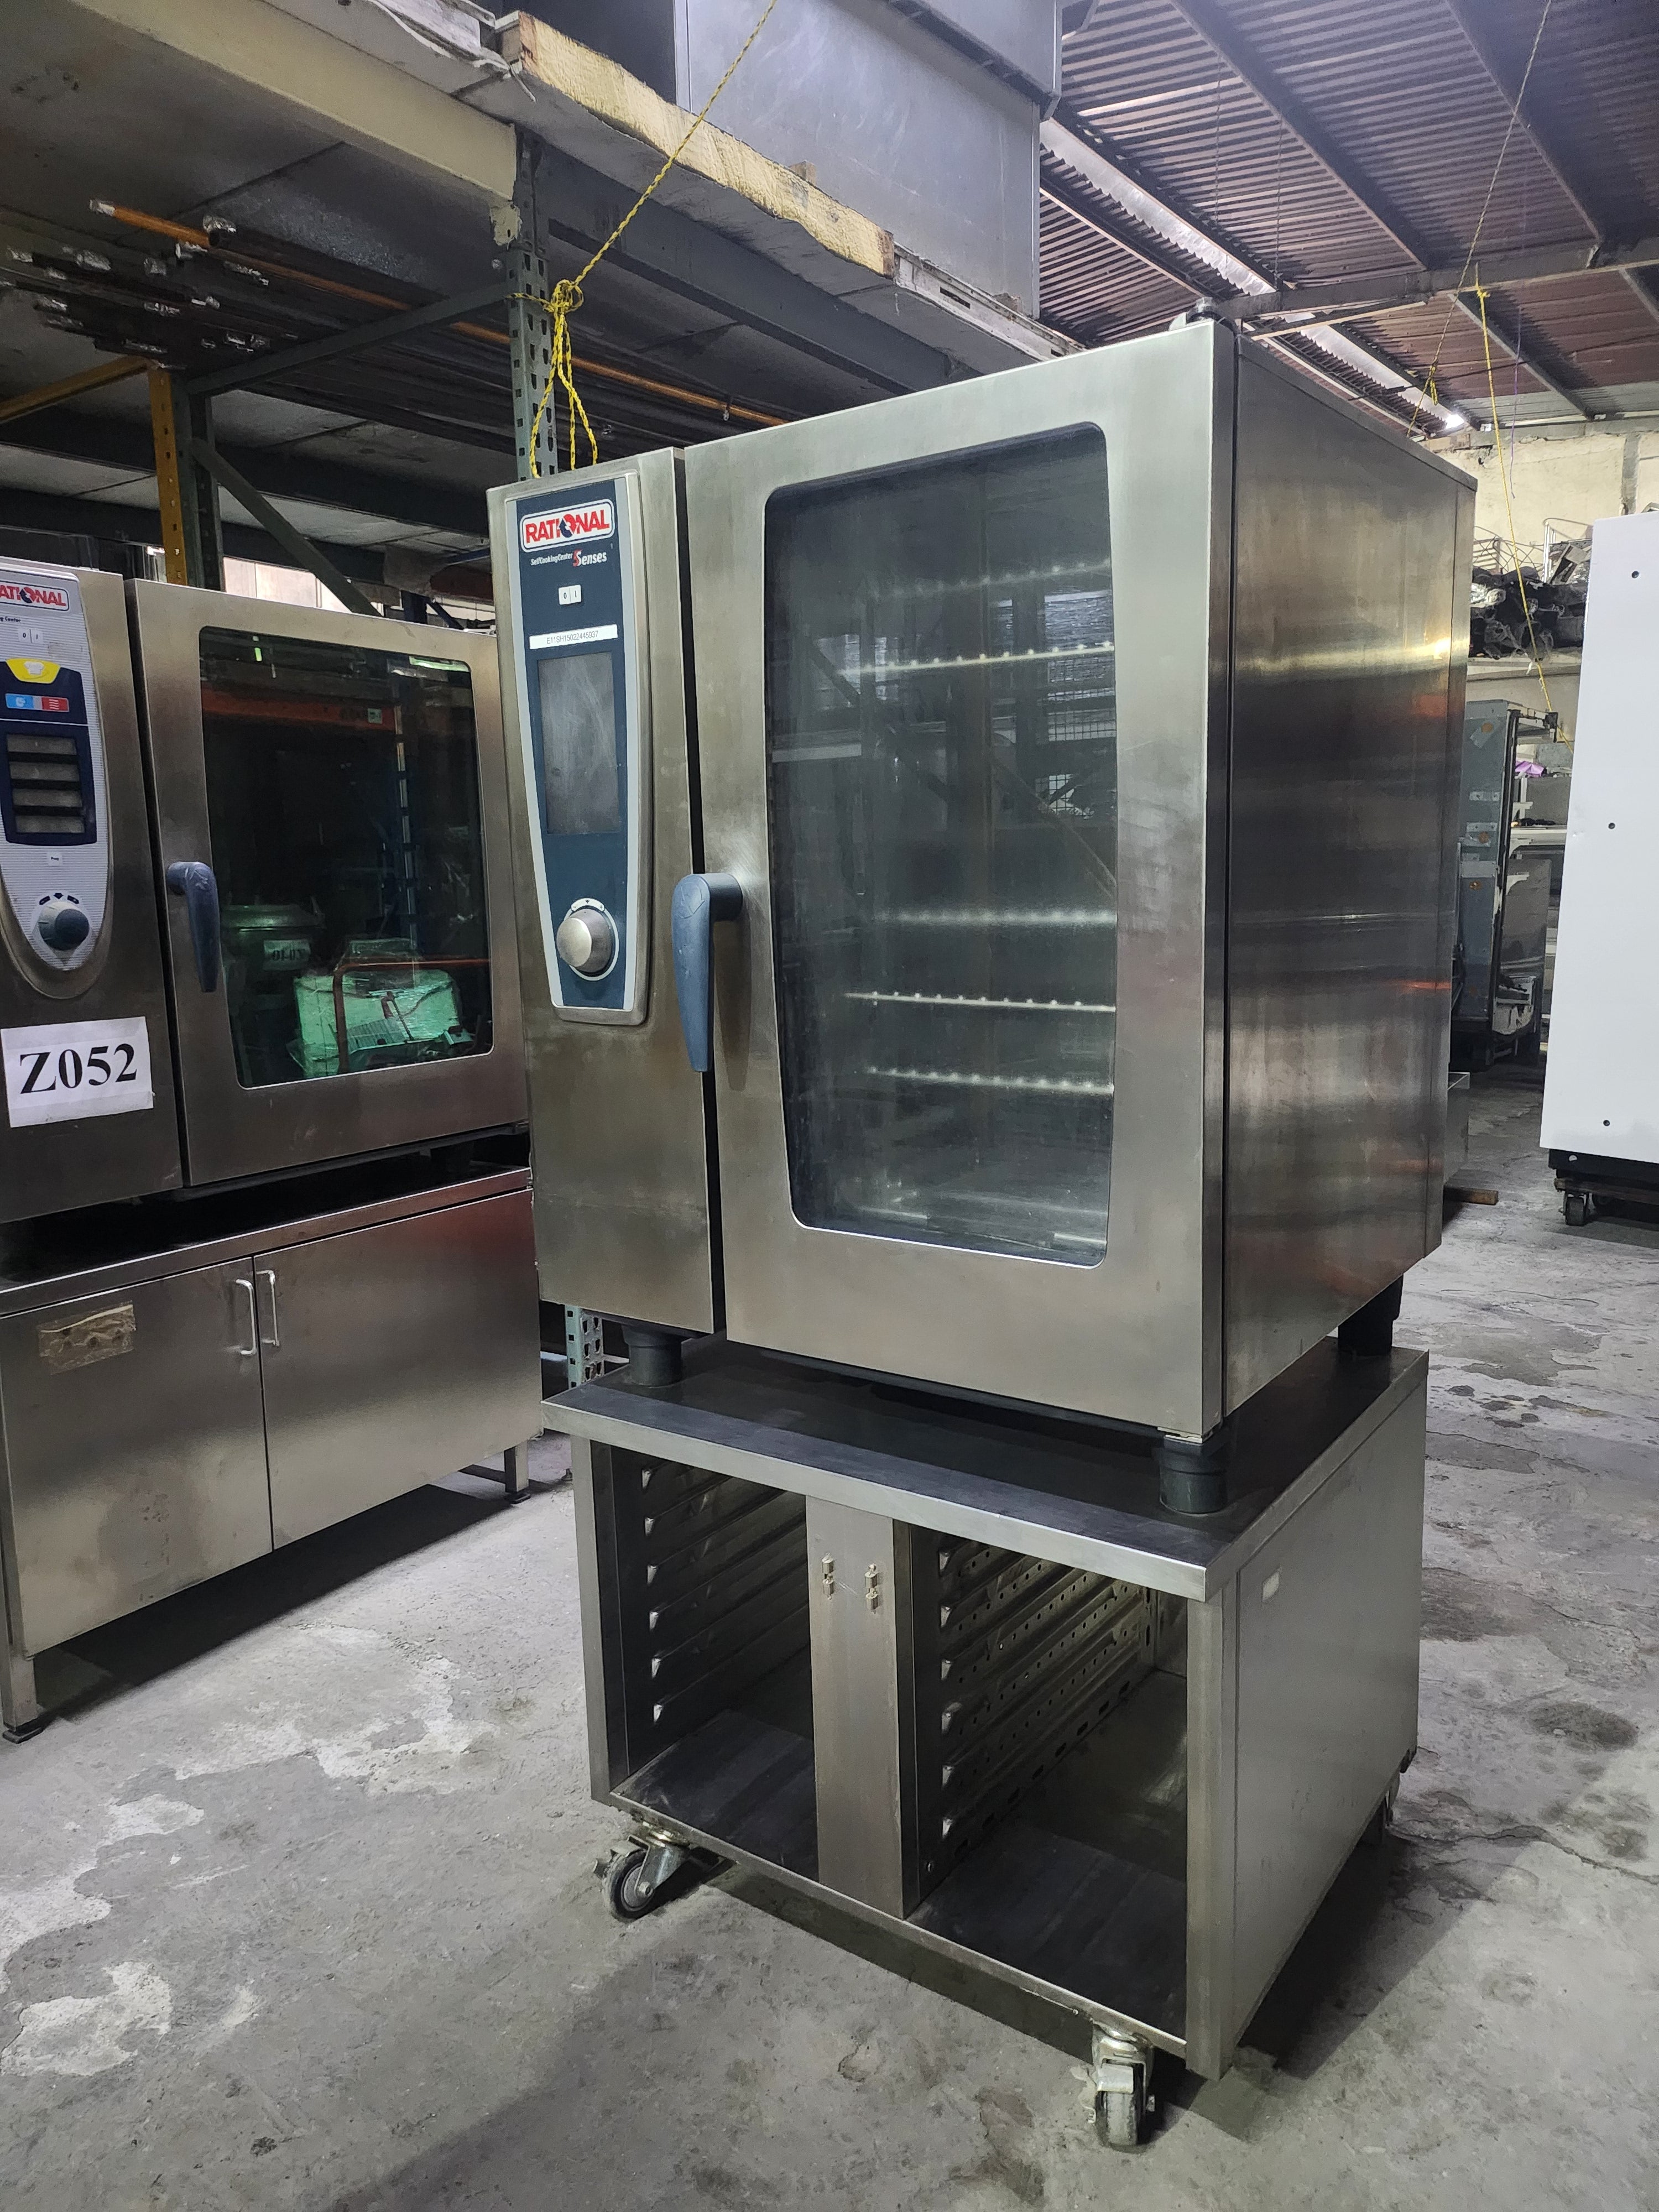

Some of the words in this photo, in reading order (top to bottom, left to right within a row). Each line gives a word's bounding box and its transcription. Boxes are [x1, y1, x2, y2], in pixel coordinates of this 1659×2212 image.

[526, 509, 610, 544] RATIONAL
[531, 552, 573, 566] SelfCookingCenter
[0, 585, 66, 606] ATIONAL
[547, 630, 598, 644] E11SH15022445937
[20, 1044, 137, 1094] Z052
